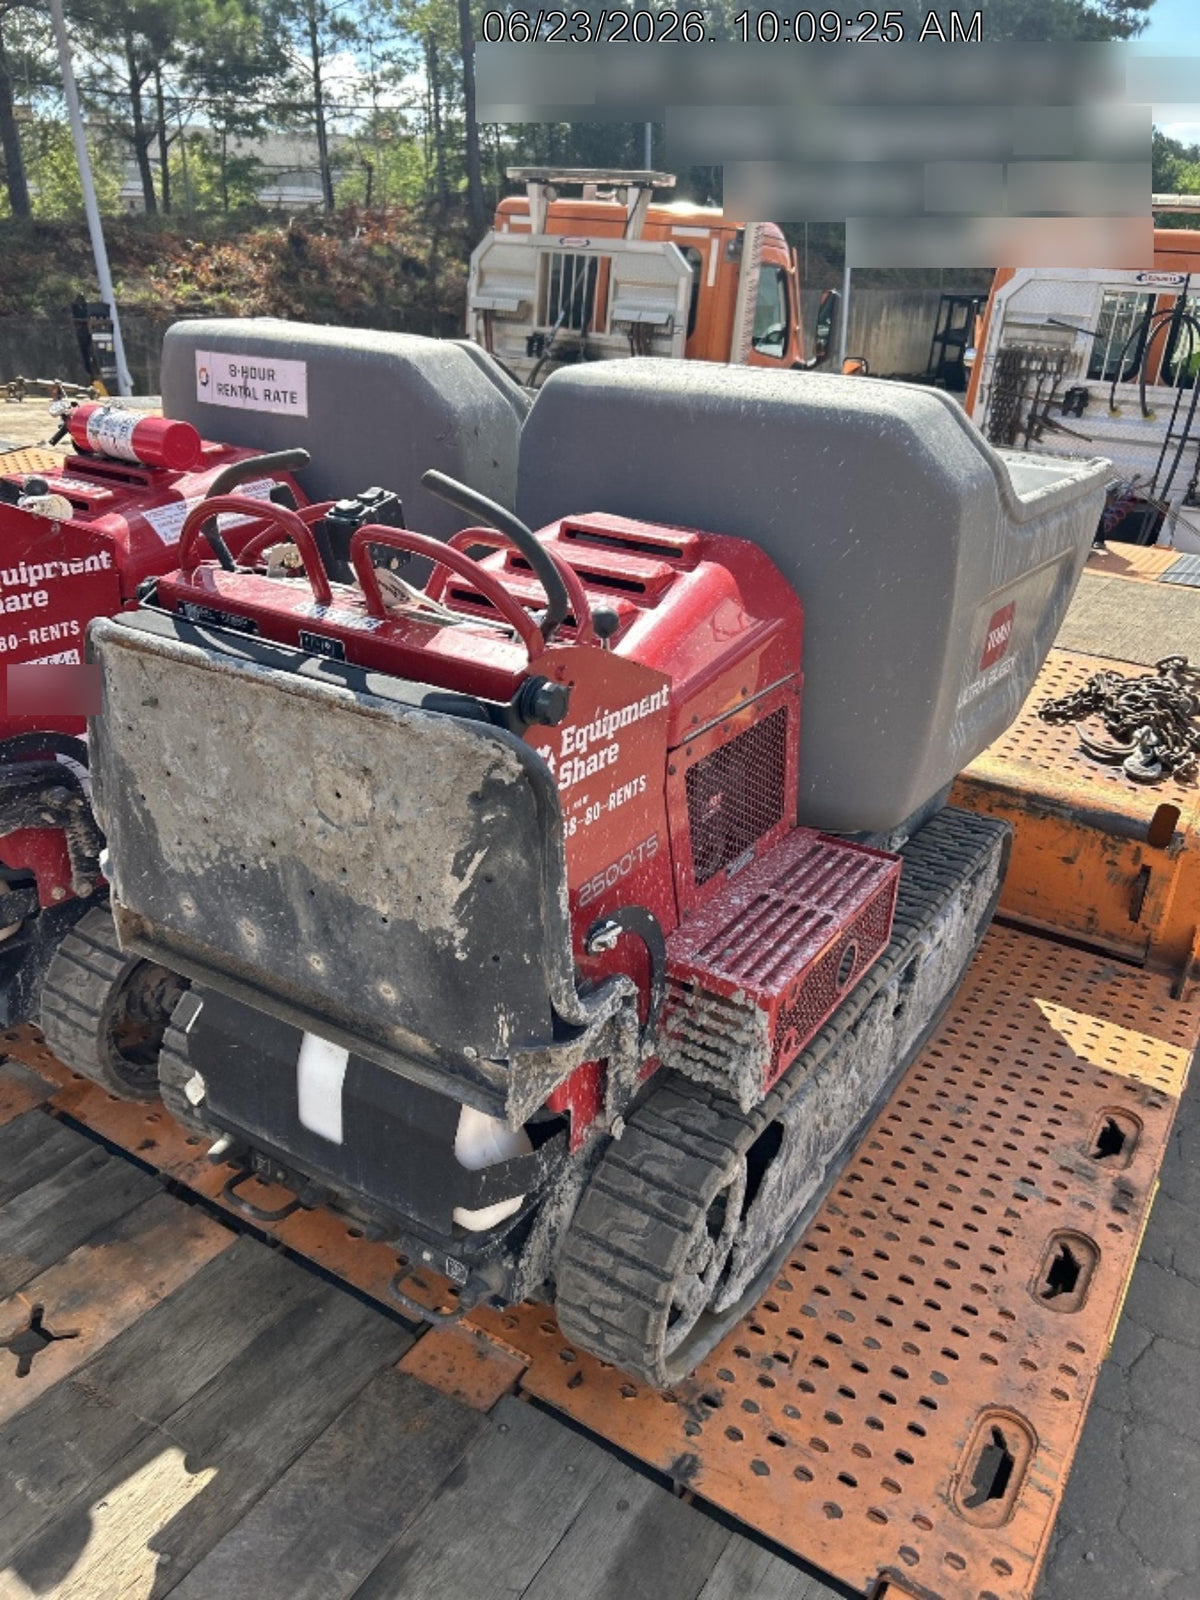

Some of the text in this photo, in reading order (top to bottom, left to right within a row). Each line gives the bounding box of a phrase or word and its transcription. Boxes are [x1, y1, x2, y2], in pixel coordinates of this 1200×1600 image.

[228, 363, 276, 382] 8-HOUR
[216, 383, 298, 405] RENTAL RATE
[0, 550, 112, 588] uipment
[560, 684, 669, 757] Equipment
[557, 742, 620, 791] Share
